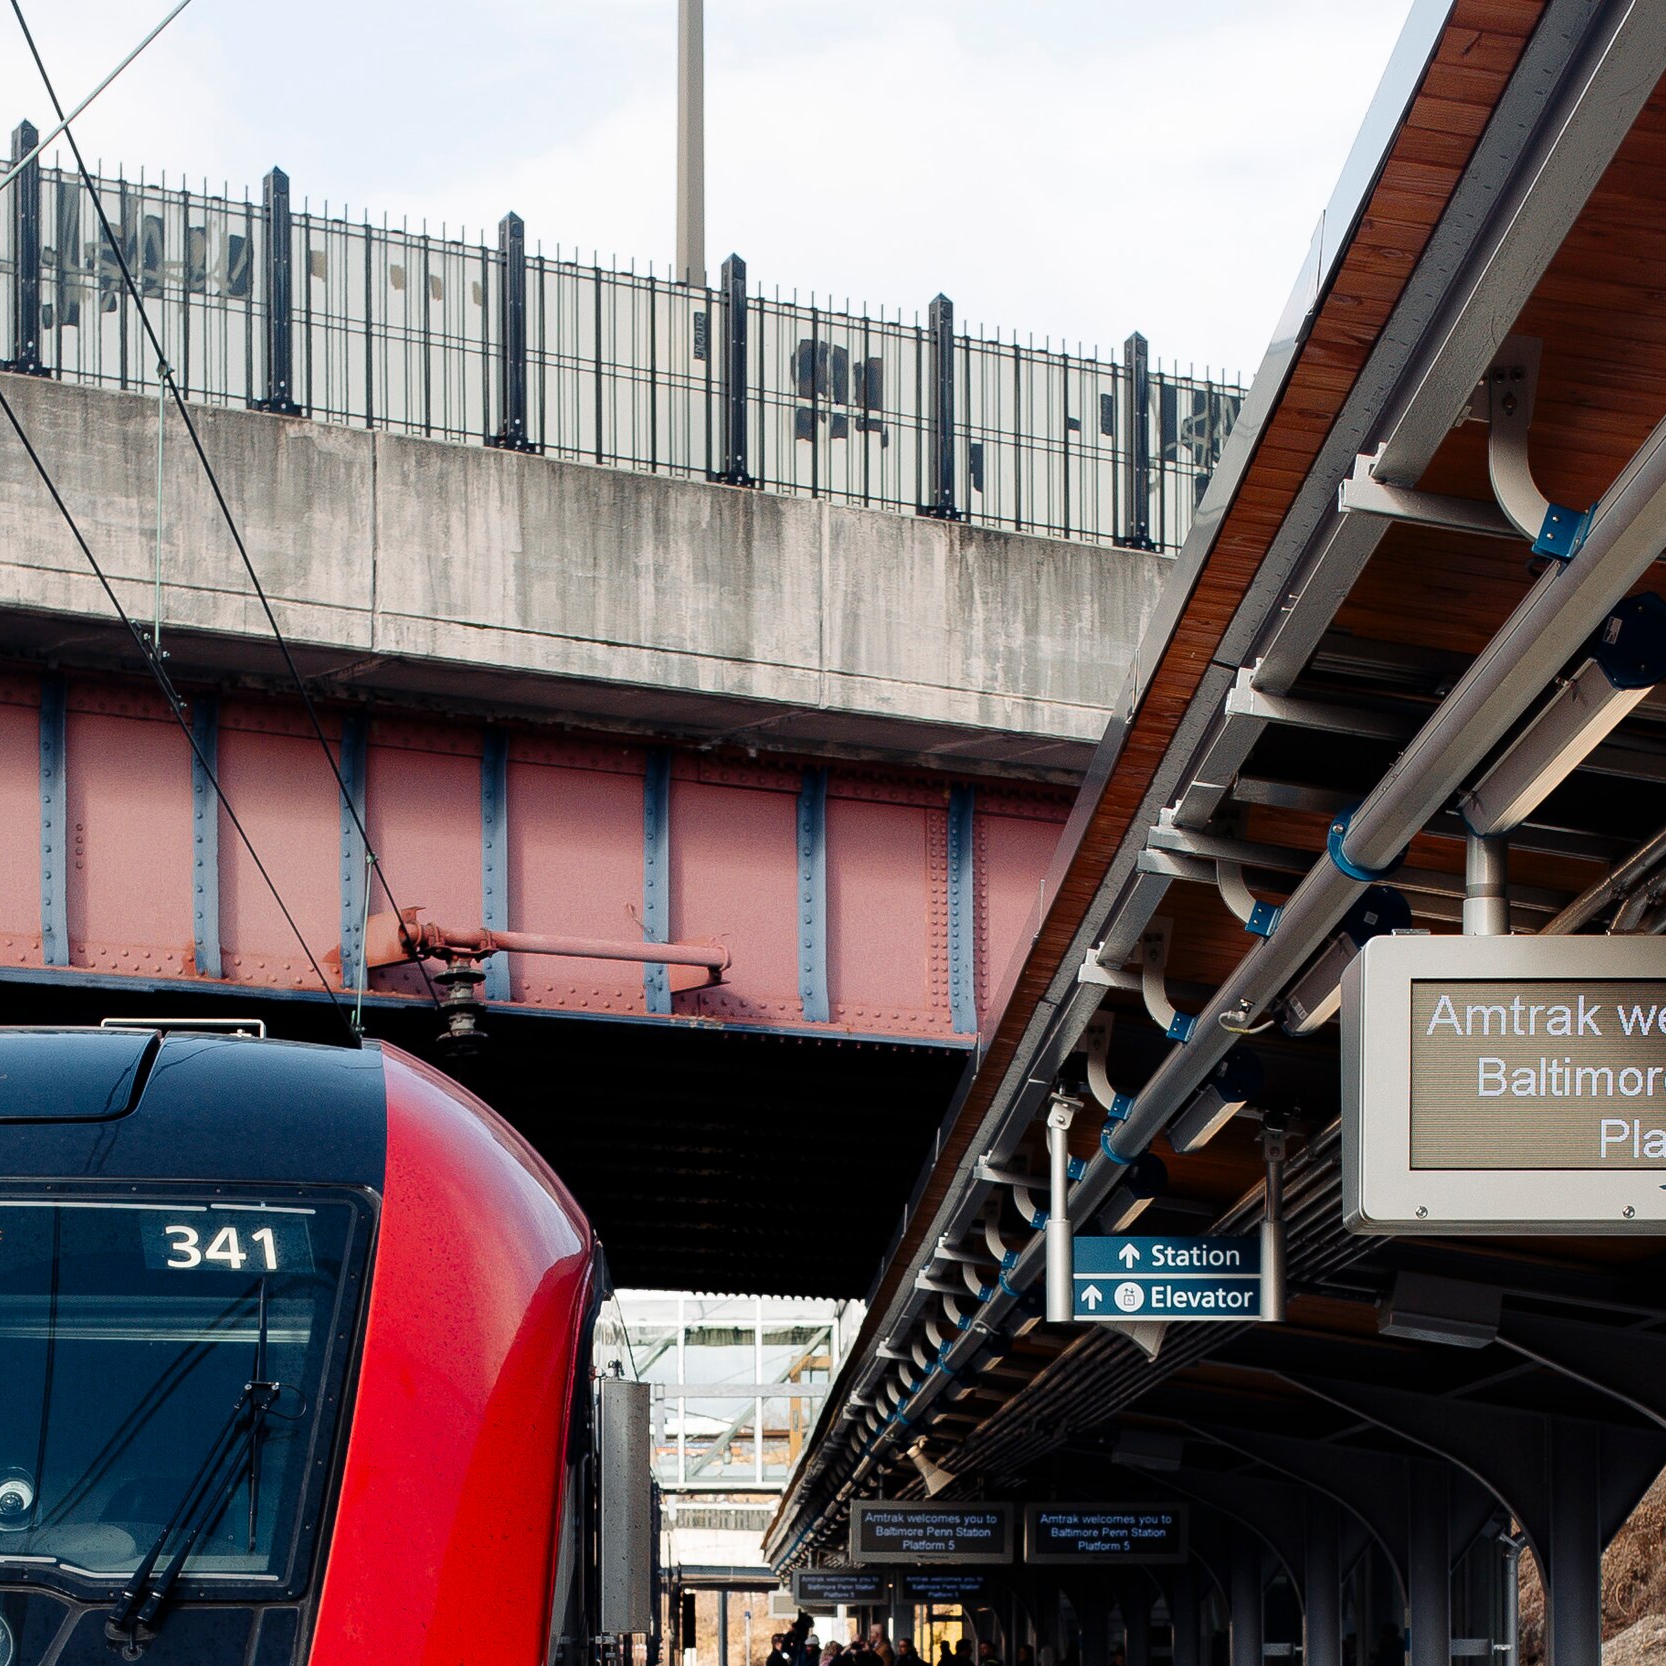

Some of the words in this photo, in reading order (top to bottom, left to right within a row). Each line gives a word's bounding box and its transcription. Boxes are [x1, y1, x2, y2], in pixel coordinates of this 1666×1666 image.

[1426, 995, 1603, 1036] Amtrak
[164, 1224, 278, 1270] 341
[1150, 1244, 1241, 1267] Station
[1150, 1285, 1254, 1308] Elevator
[864, 1512, 904, 1523] Amtrak
[907, 1513, 960, 1523] welcomes
[964, 1515, 983, 1526] you
[986, 1514, 997, 1524] to
[1040, 1514, 1079, 1524] Amtrak
[1082, 1514, 1136, 1524] welcomes
[1139, 1516, 1158, 1526] you
[1161, 1515, 1172, 1524] to
[876, 1526, 923, 1536] Baltimore
[926, 1527, 953, 1536] Penn
[955, 1527, 991, 1537] Station
[1051, 1527, 1098, 1537] Baltimore
[1102, 1527, 1128, 1537] Penn
[1131, 1527, 1166, 1537] Station
[902, 1540, 945, 1550] Platform
[948, 1540, 956, 1550] 5
[1078, 1541, 1121, 1551] Platform
[1123, 1541, 1131, 1551] 5
